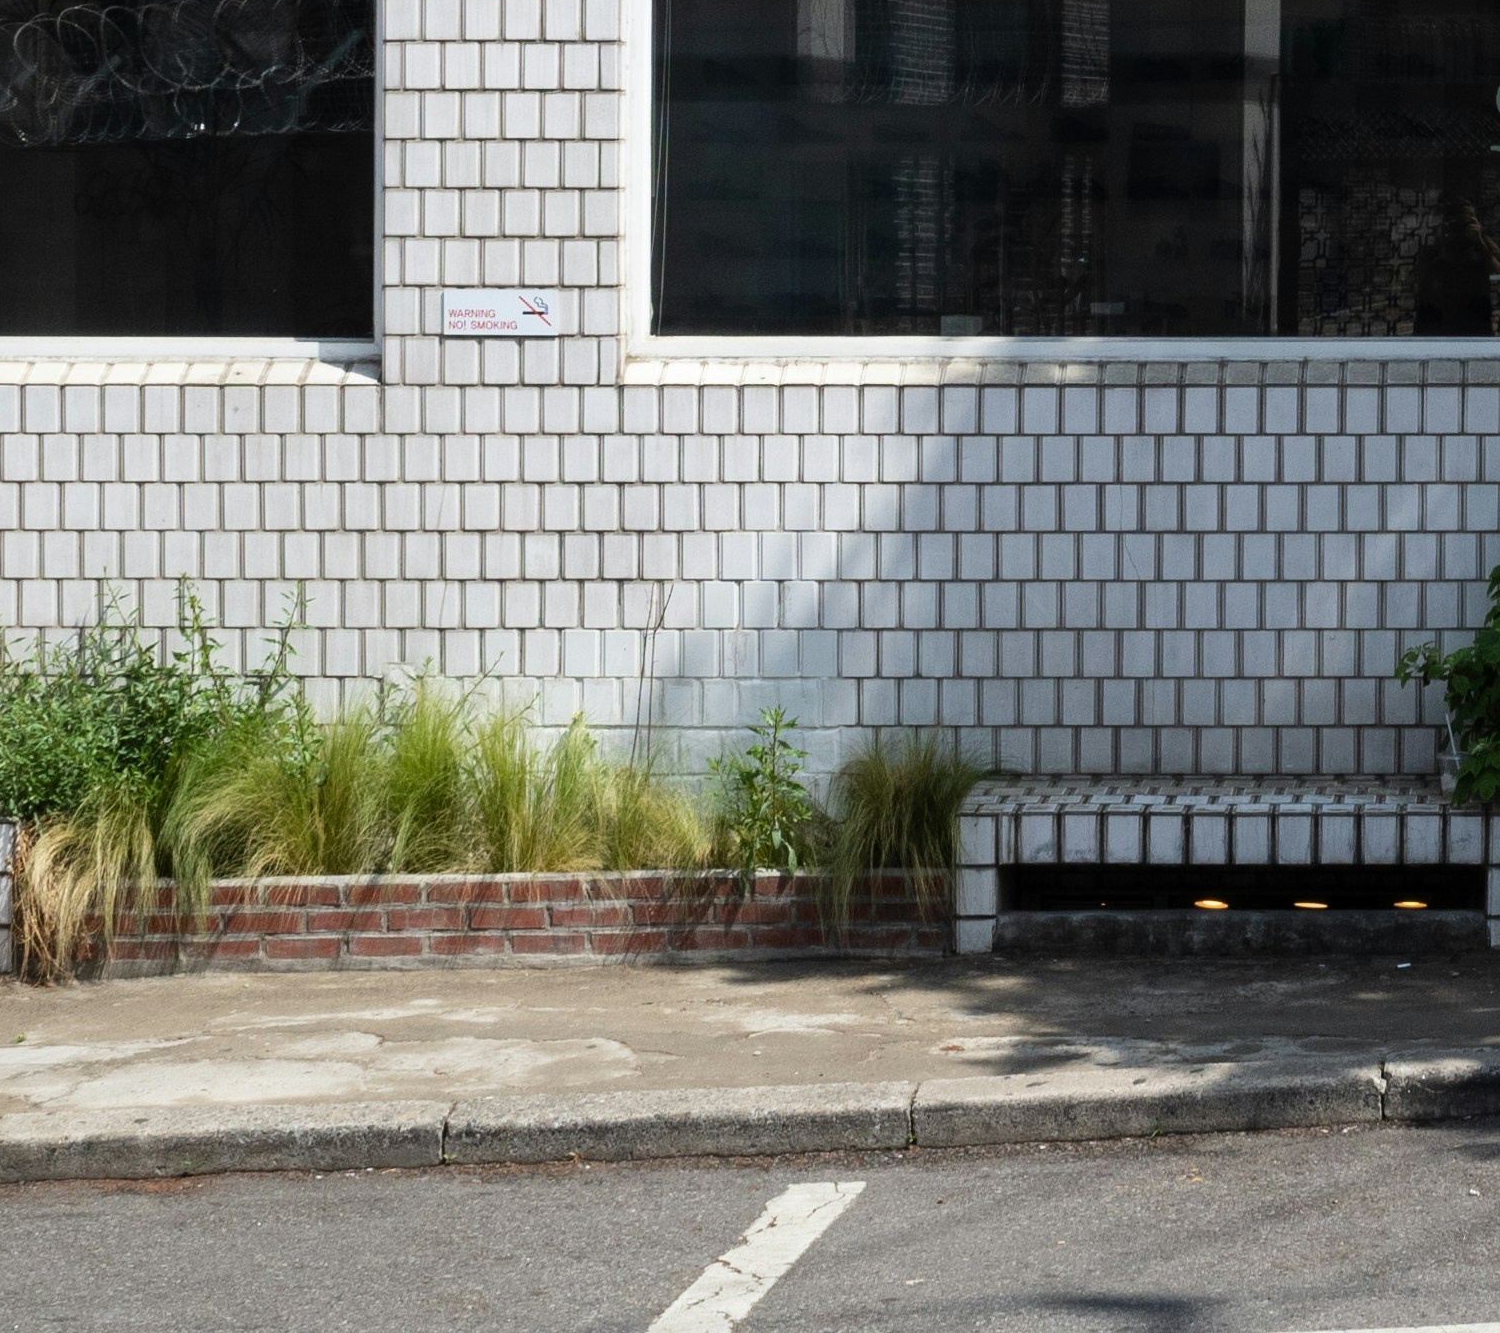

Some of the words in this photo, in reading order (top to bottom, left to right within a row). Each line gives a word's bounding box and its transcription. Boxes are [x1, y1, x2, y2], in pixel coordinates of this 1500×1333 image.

[448, 309, 496, 318] WARNING
[448, 320, 467, 330] NO!
[471, 320, 518, 330] SMOKING
